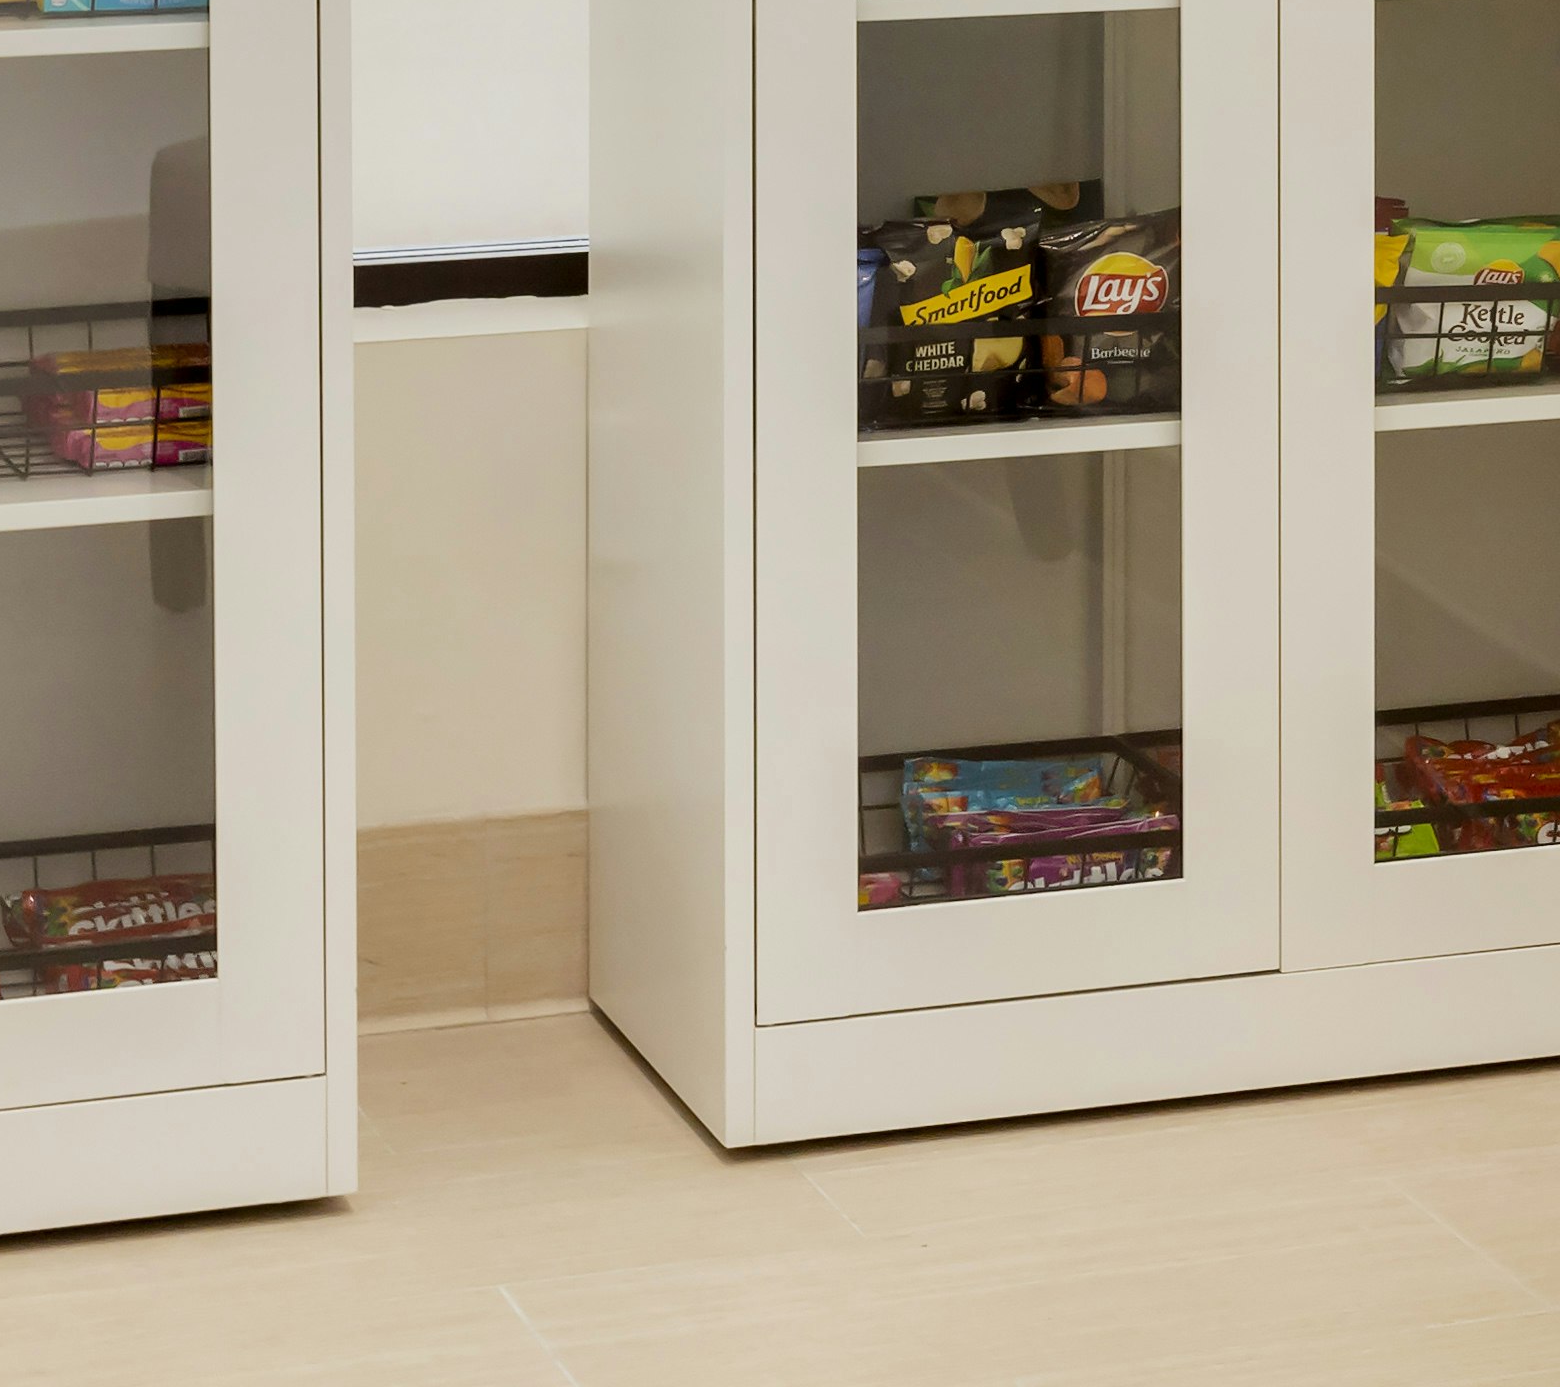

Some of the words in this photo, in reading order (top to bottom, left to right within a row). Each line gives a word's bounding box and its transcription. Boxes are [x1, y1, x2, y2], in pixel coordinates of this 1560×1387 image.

[910, 276, 1023, 325] Smartfood
[1082, 272, 1162, 315] Lay's
[905, 355, 965, 372] CHEDDAR
[915, 342, 956, 357] WHITE
